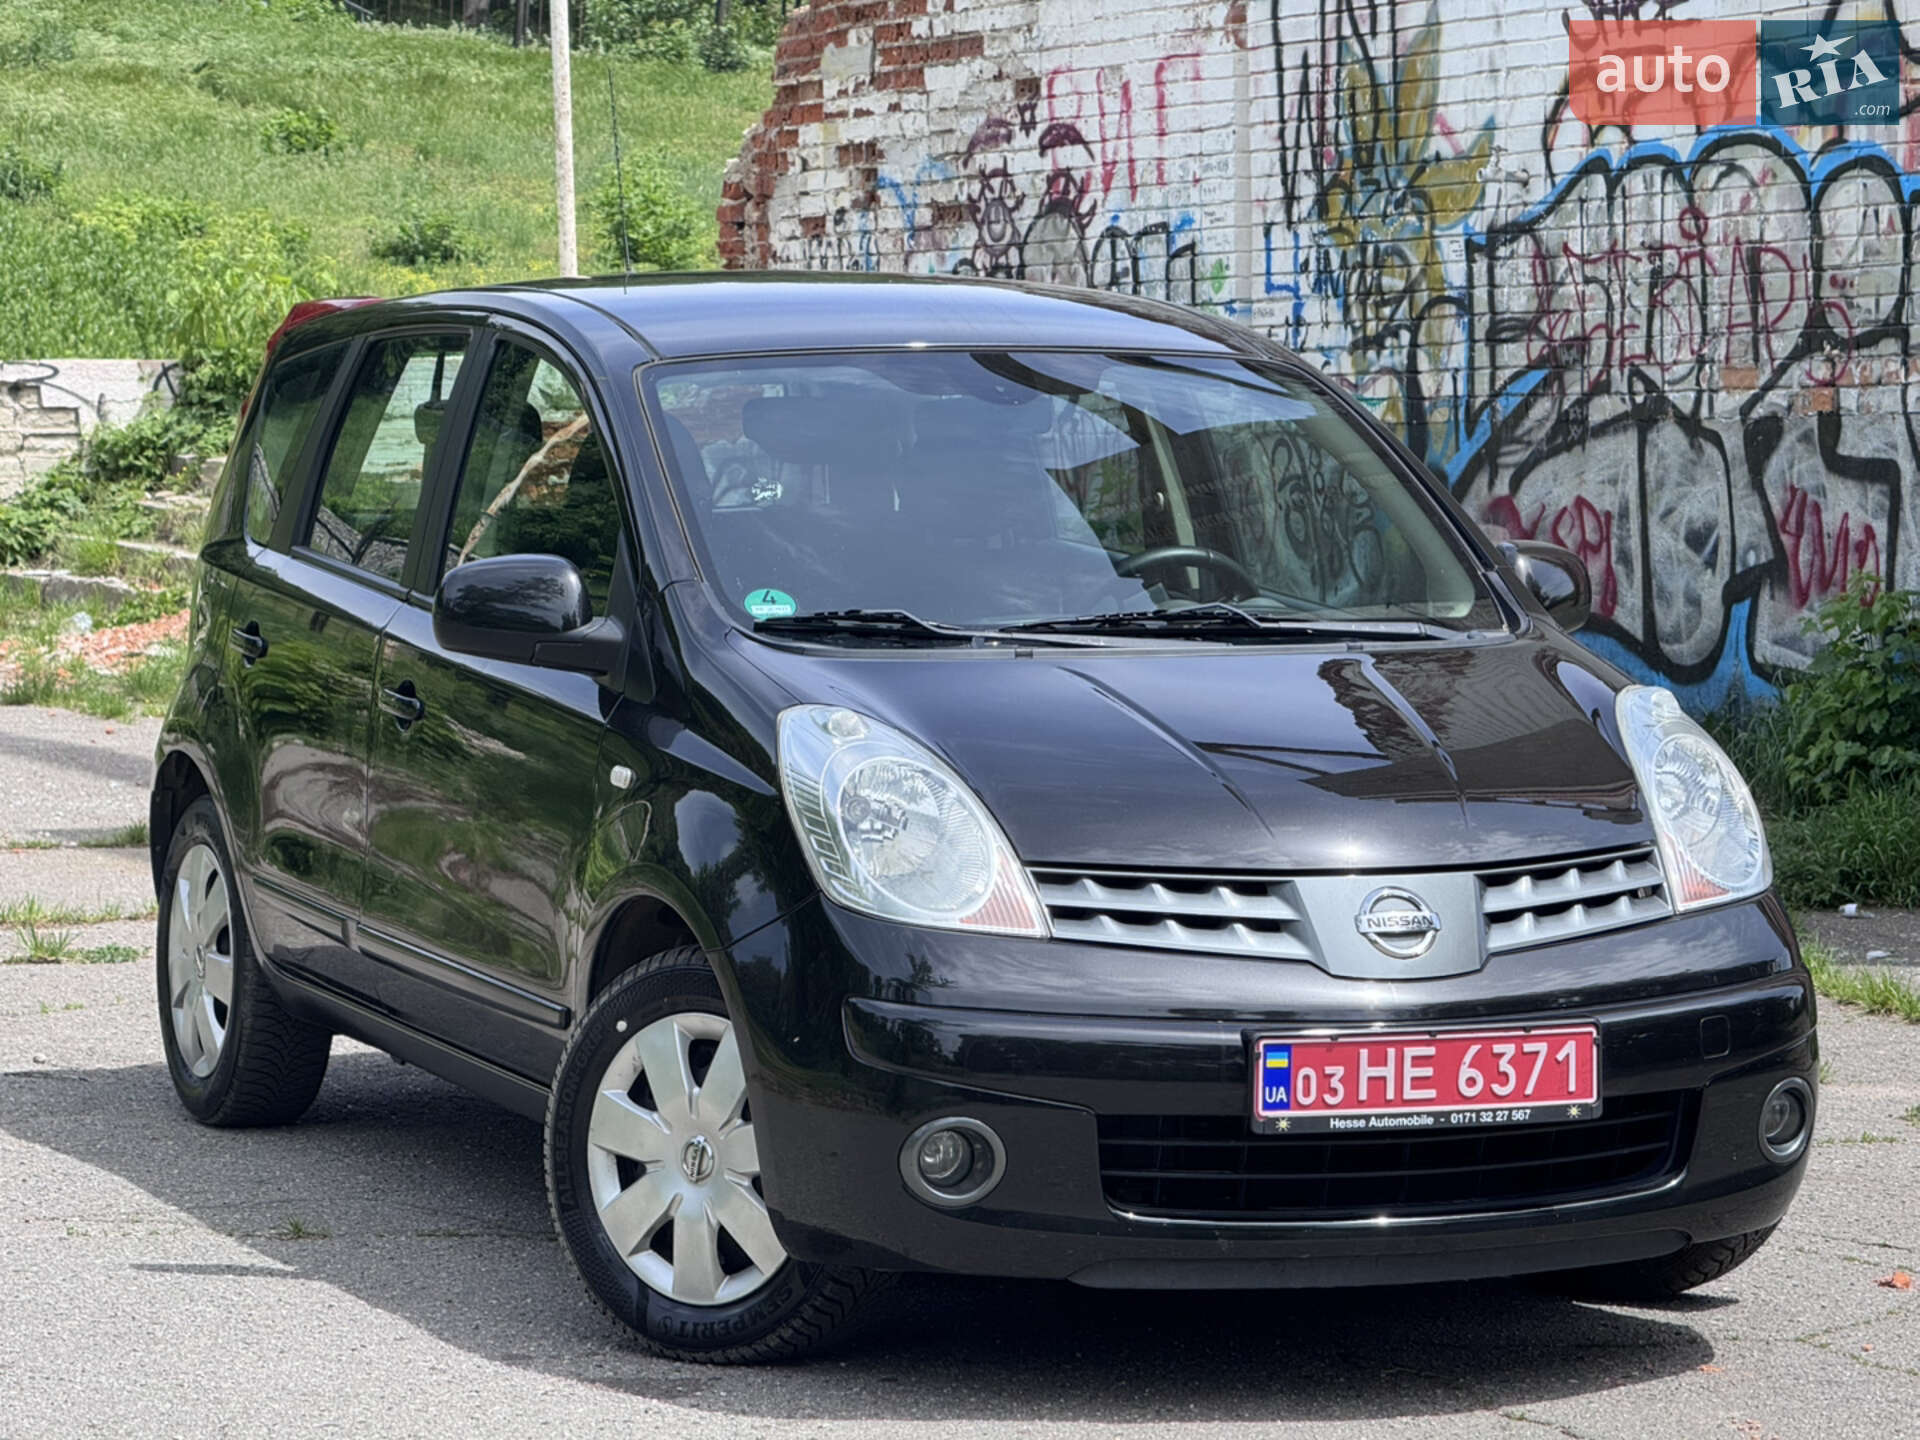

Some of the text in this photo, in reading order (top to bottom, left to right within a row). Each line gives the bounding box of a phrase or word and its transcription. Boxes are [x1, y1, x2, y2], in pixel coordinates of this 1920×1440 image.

[762, 590, 777, 605] 4
[1367, 915, 1434, 929] NISSAN
[1296, 1040, 1577, 1106] 03 HE 6371
[1265, 1086, 1287, 1103] UA
[1330, 1117, 1366, 1129] Hesse
[1368, 1114, 1434, 1127] Automobile
[1451, 1113, 1476, 1124] 0171
[1480, 1111, 1493, 1122] 32
[1496, 1110, 1509, 1121] 27
[1511, 1109, 1531, 1120] 567
